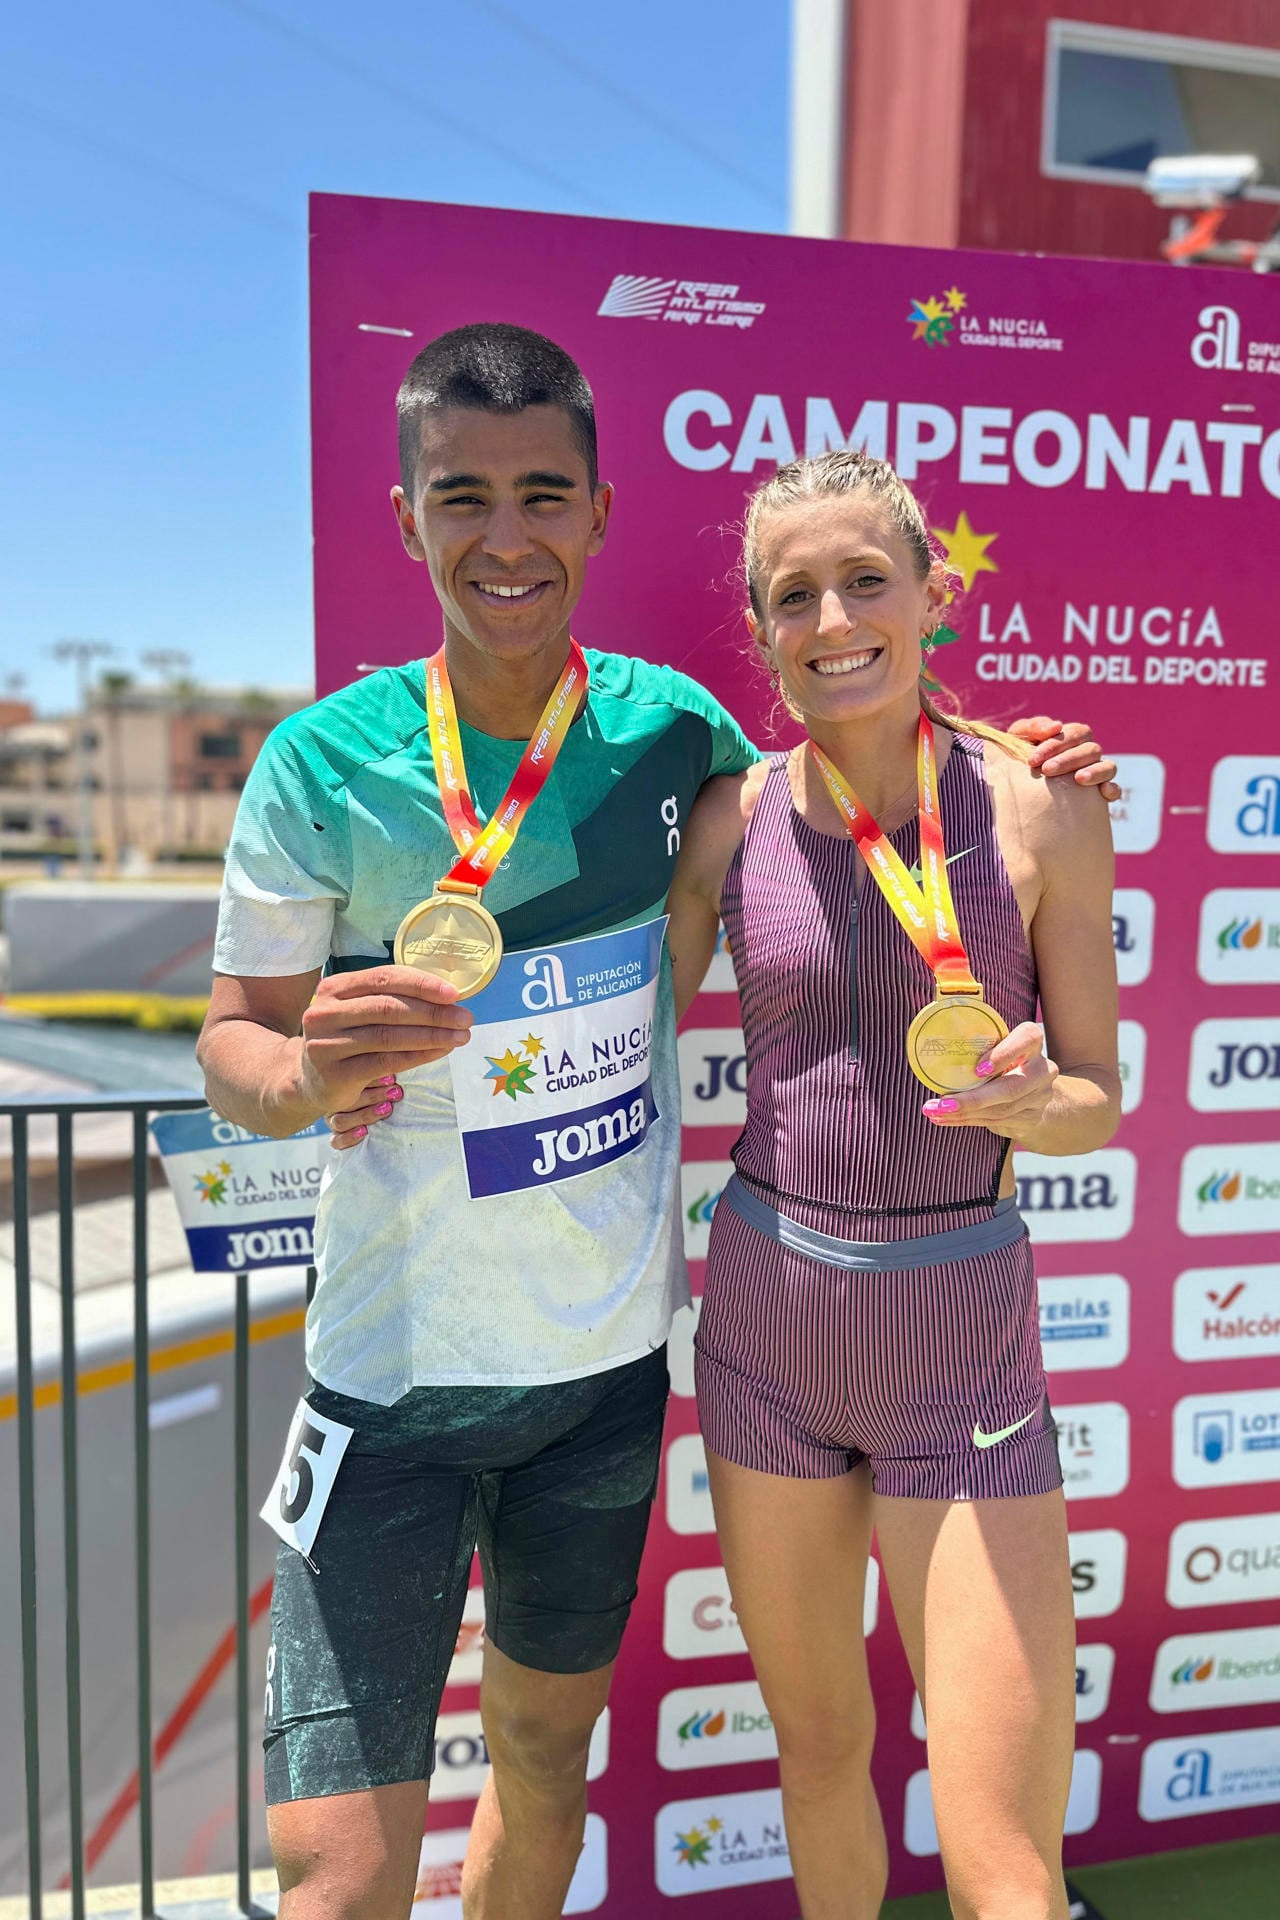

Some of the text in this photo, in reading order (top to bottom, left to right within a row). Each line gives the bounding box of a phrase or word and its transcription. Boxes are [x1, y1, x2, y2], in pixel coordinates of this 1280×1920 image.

[960, 316, 980, 332] LA
[979, 602, 1031, 643] LA
[976, 653, 1267, 687] CIUDAD DEL DEPORTE
[577, 960, 642, 987] DIPUTACIÓN
[578, 975, 642, 1001] DE ALICANTE
[544, 1048, 576, 1076] LA
[546, 1070, 597, 1092] CIUDAD
[600, 1063, 620, 1079] DEL
[232, 1175, 257, 1193] LA
[234, 1190, 277, 1206] CIUDAD
[279, 1420, 327, 1524] 5
[721, 1829, 747, 1851] LA
